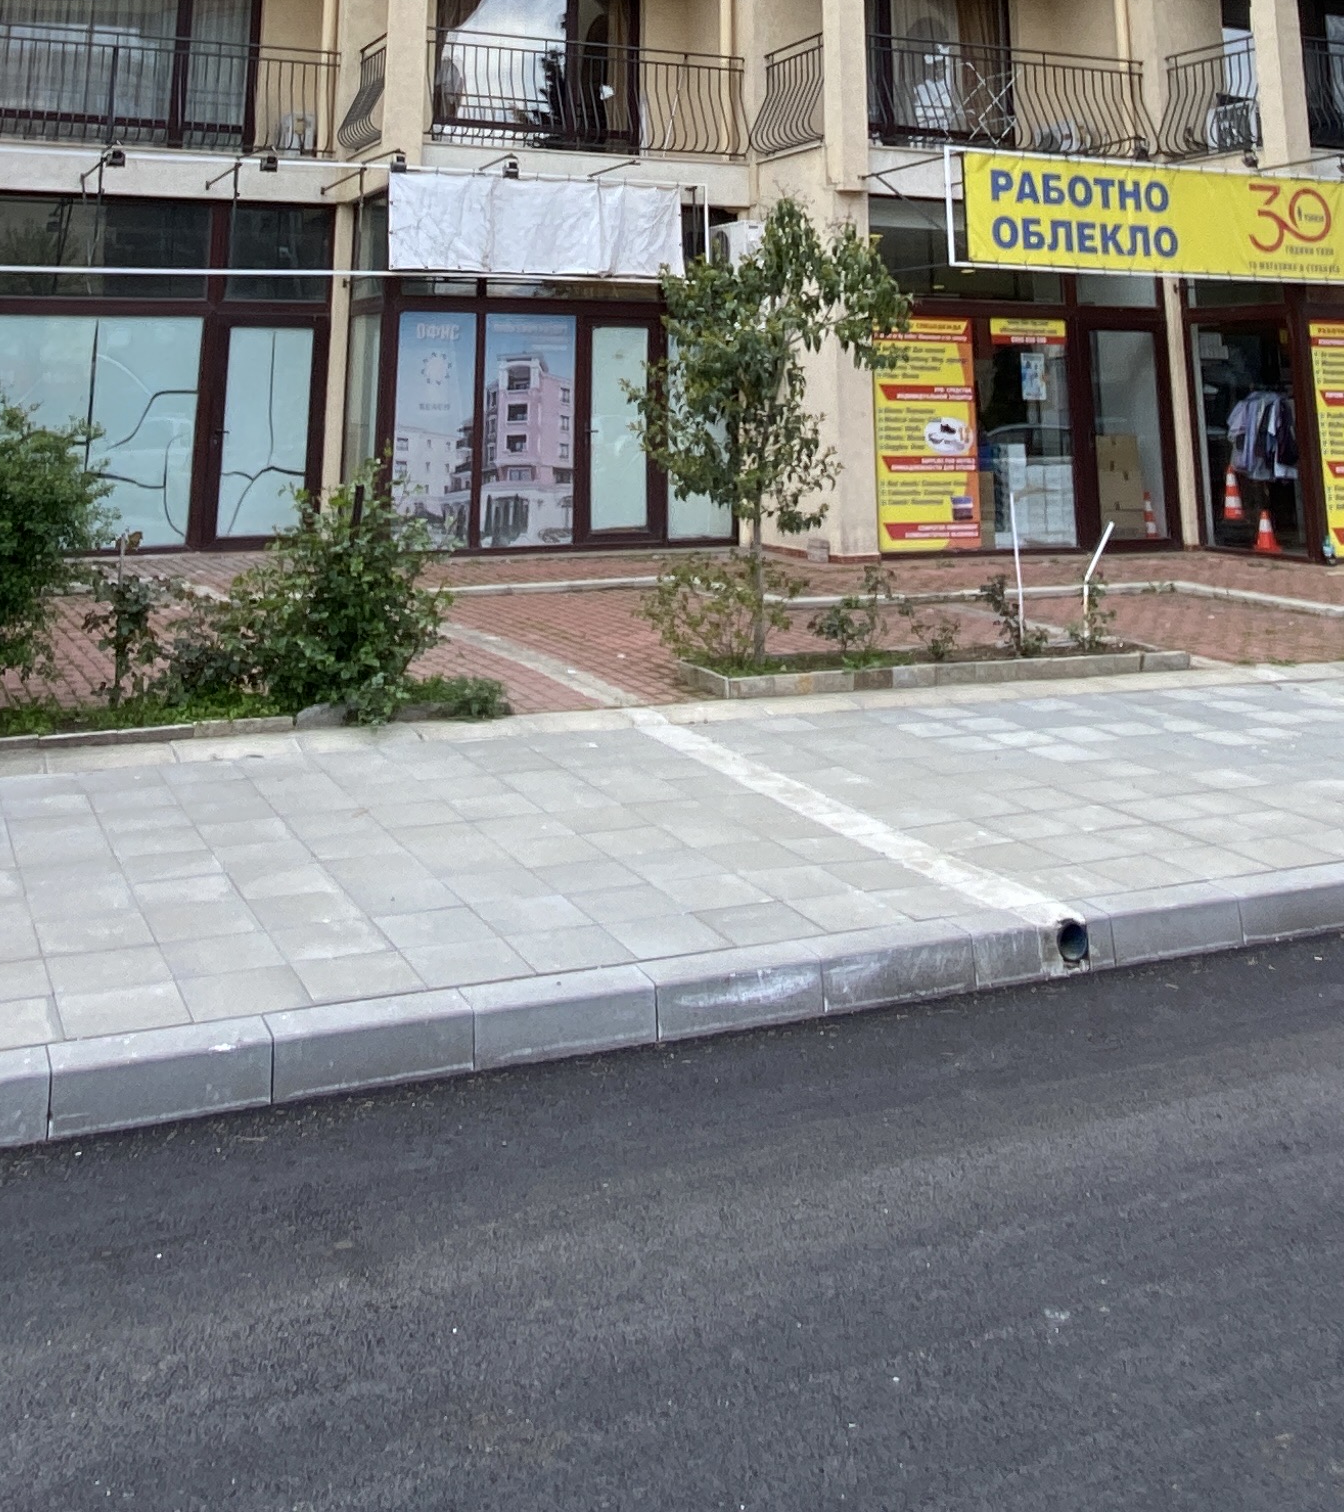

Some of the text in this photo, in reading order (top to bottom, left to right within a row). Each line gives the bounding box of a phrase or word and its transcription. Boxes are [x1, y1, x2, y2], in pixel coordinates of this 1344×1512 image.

[989, 168, 1170, 213] РАБОТНО
[991, 215, 1179, 259] ОБЛЕКЛО
[1248, 183, 1332, 253] 30
[416, 322, 460, 341] ОФИС
